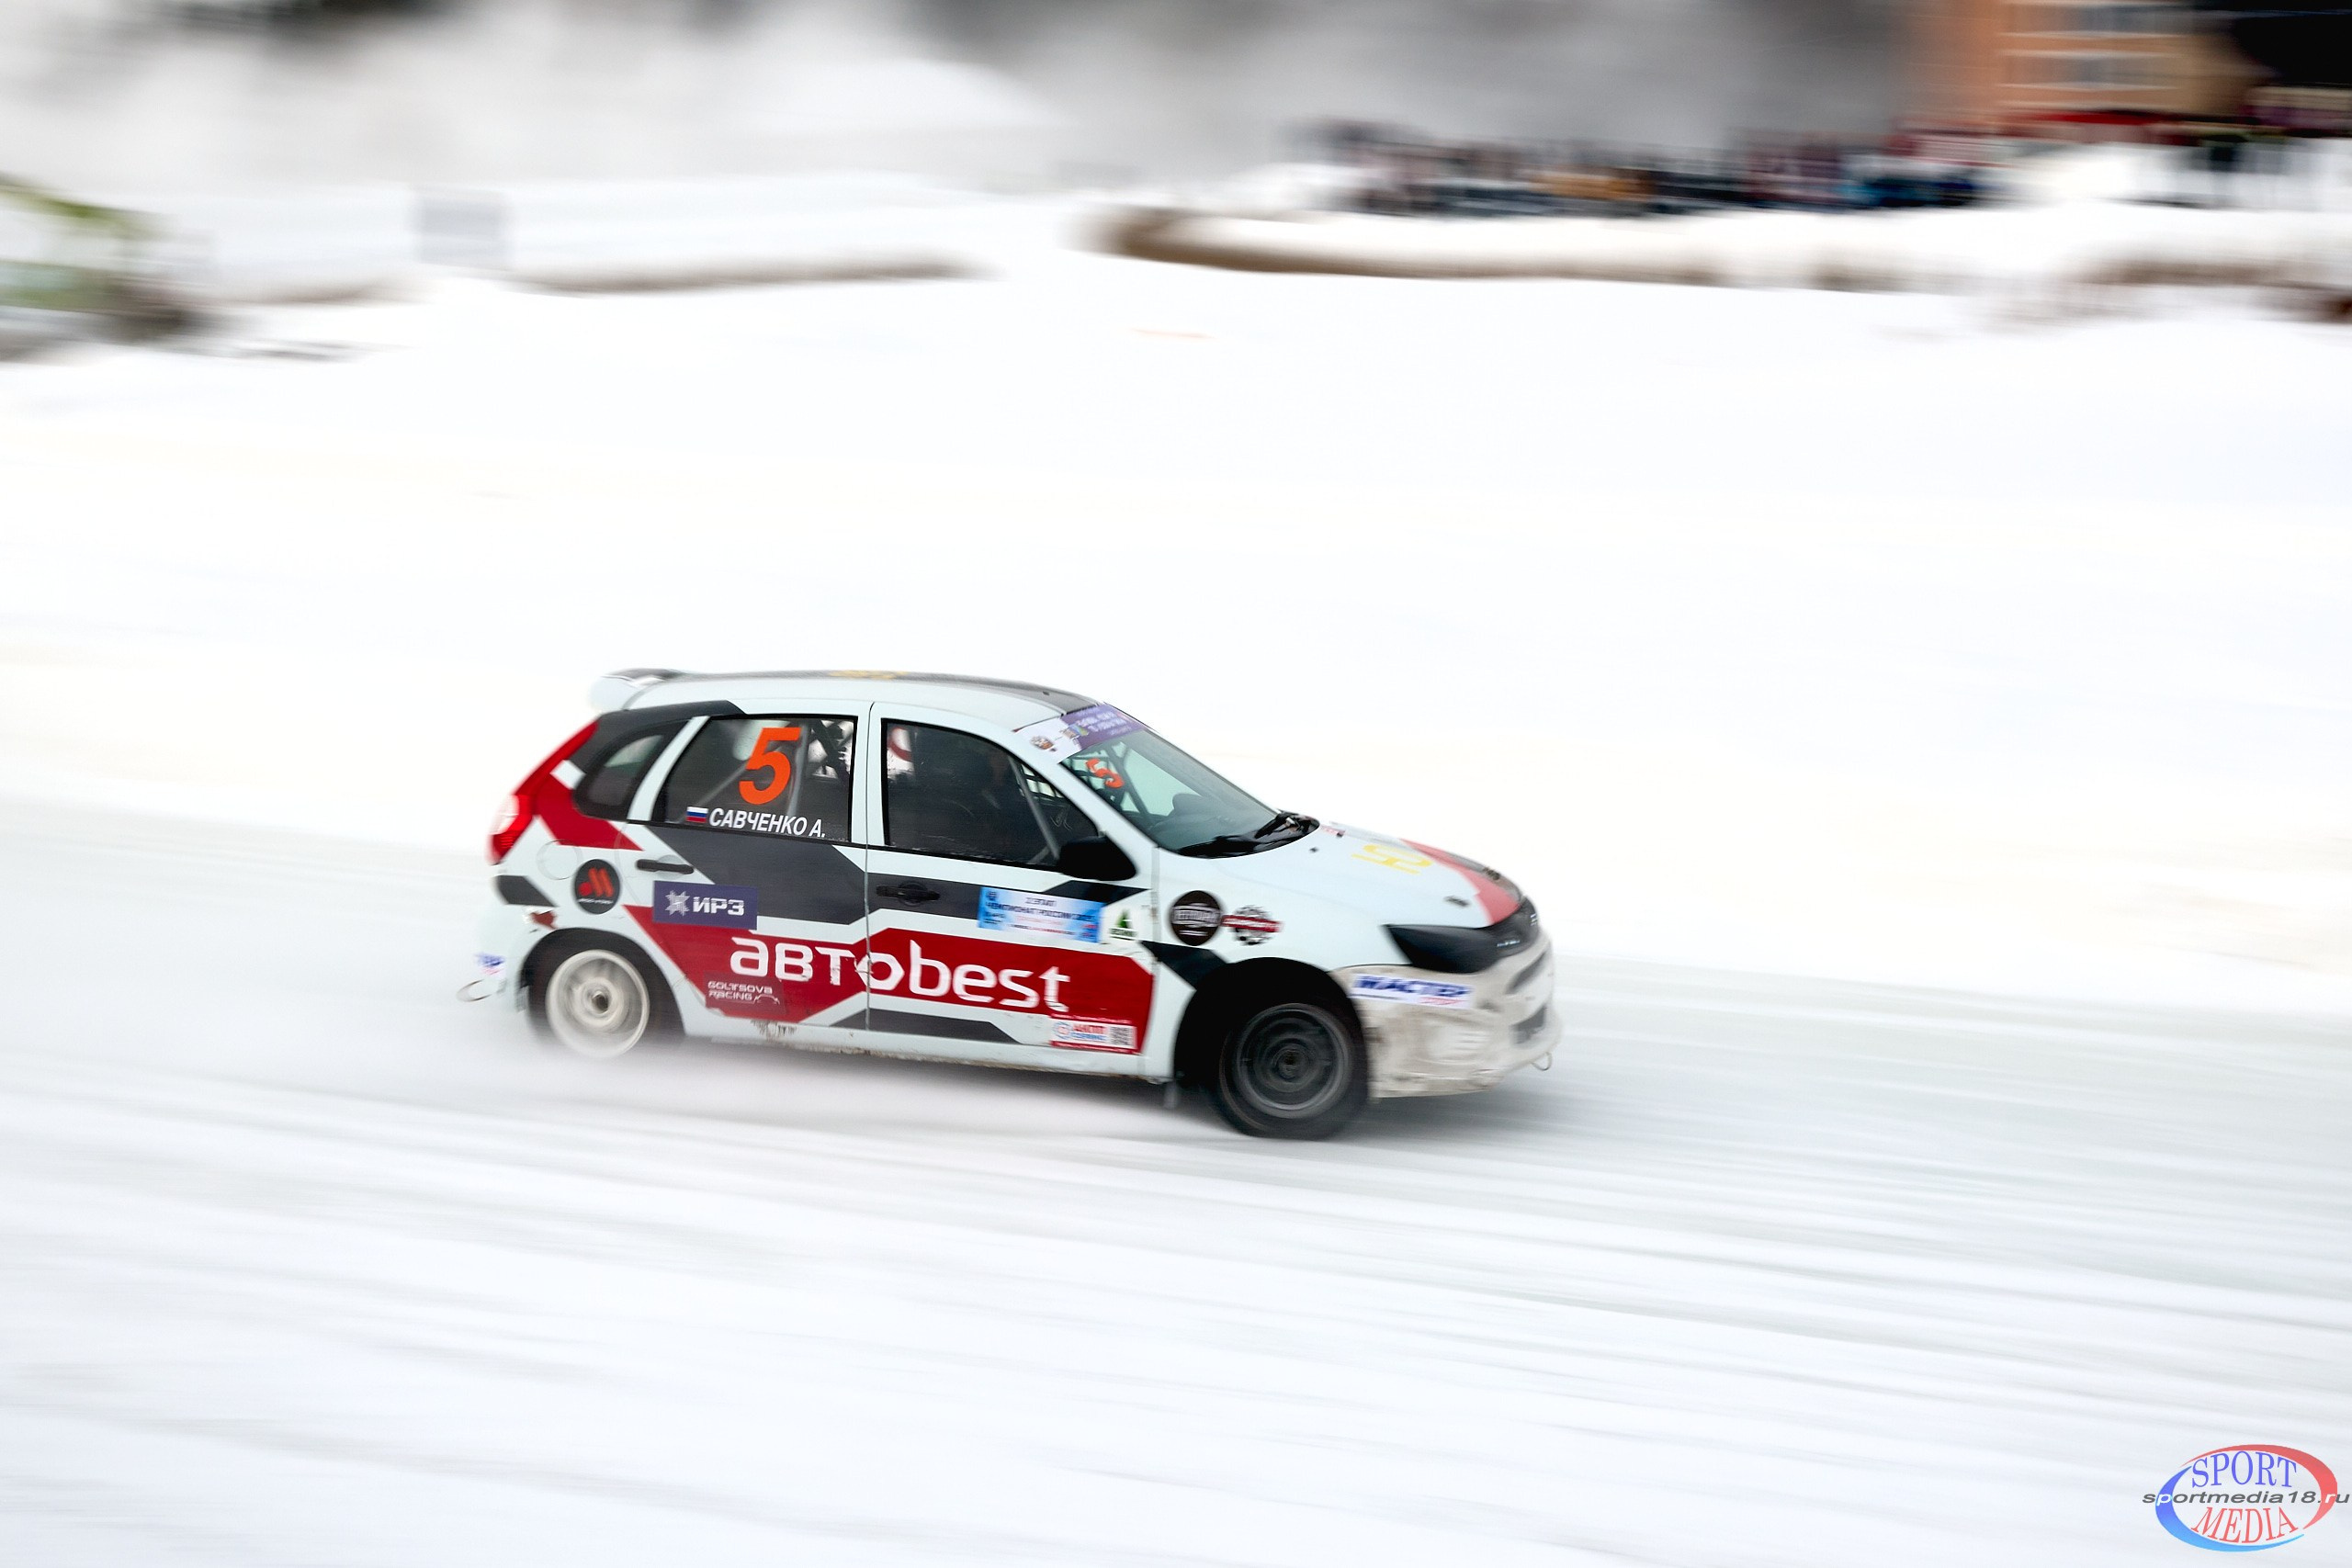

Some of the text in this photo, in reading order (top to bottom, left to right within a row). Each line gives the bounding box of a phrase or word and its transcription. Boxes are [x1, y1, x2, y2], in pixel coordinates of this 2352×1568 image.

[739, 727, 802, 805] 5
[709, 808, 826, 838] САВЧЕНКО А.
[693, 896, 745, 917] ИРЗ
